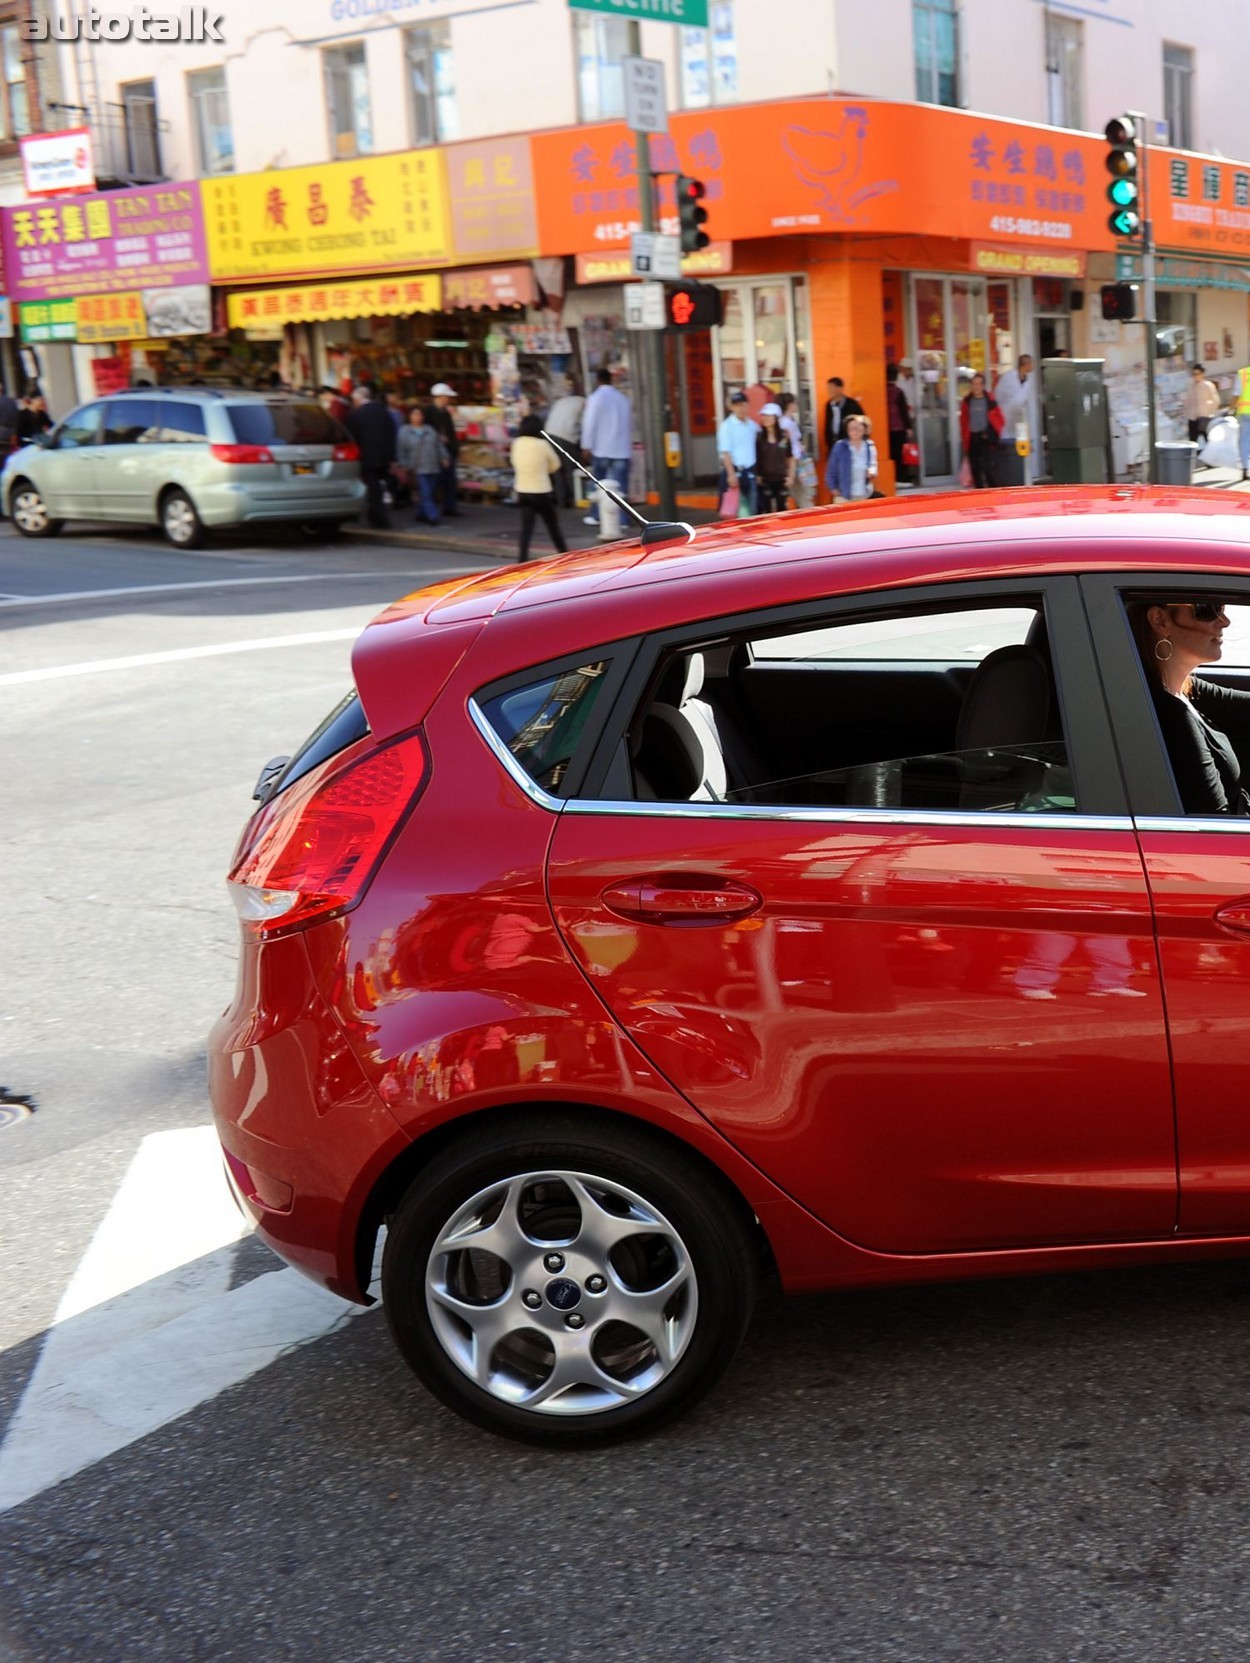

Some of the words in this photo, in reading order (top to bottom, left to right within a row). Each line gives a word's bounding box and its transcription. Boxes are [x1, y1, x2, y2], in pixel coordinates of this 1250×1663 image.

[633, 65, 655, 79] NO
[632, 81, 658, 95] TURN
[584, 258, 634, 279] GRAN
